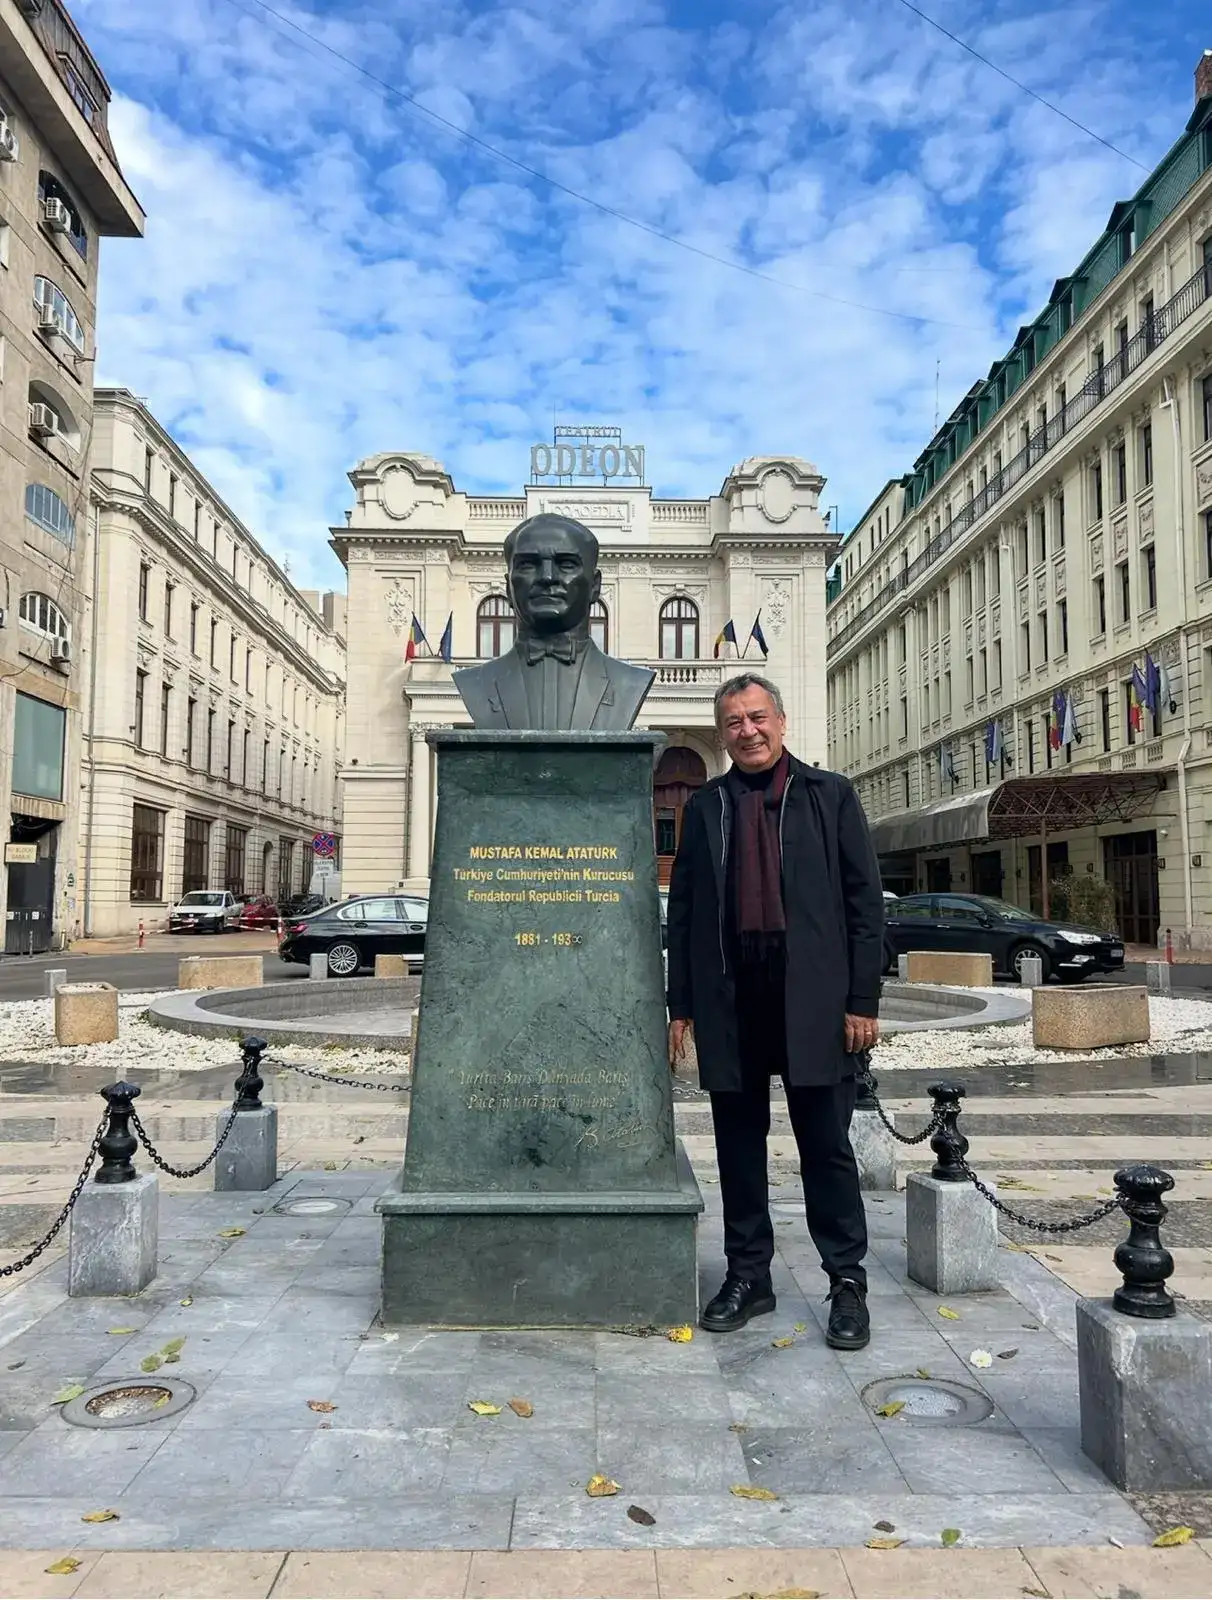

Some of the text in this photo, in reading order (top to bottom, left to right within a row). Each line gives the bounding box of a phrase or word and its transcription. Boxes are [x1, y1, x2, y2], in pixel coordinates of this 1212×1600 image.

[532, 443, 645, 477] ODEON
[470, 847, 522, 860] MUSTAFA
[525, 847, 564, 860] KEMAL
[496, 867, 580, 883] Cumhuriyeti'nin
[582, 867, 635, 881] Kurucusu
[467, 889, 620, 904] Fondatorul Republicii Turcia
[514, 933, 541, 946] 1881
